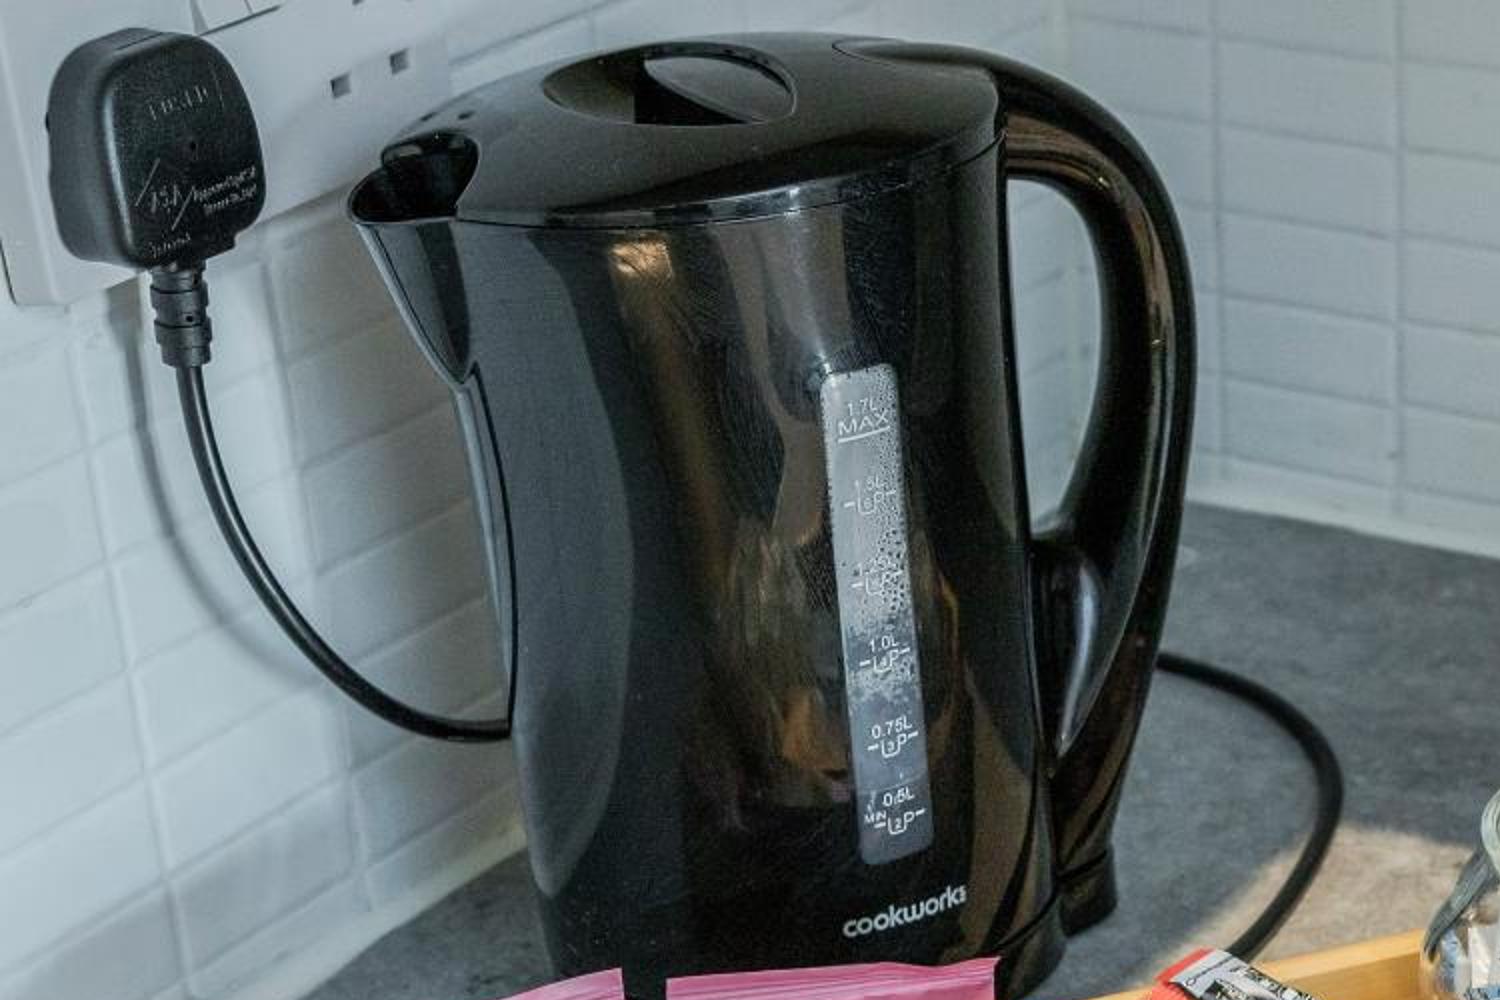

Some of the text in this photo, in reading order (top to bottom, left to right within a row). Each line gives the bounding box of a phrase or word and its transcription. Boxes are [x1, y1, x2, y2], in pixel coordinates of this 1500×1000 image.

[838, 410, 890, 436] MAX
[869, 634, 900, 652] 1.0L
[872, 717, 912, 739] 0.75L
[883, 788, 914, 807] 0.5L
[843, 884, 968, 938] cookworks
